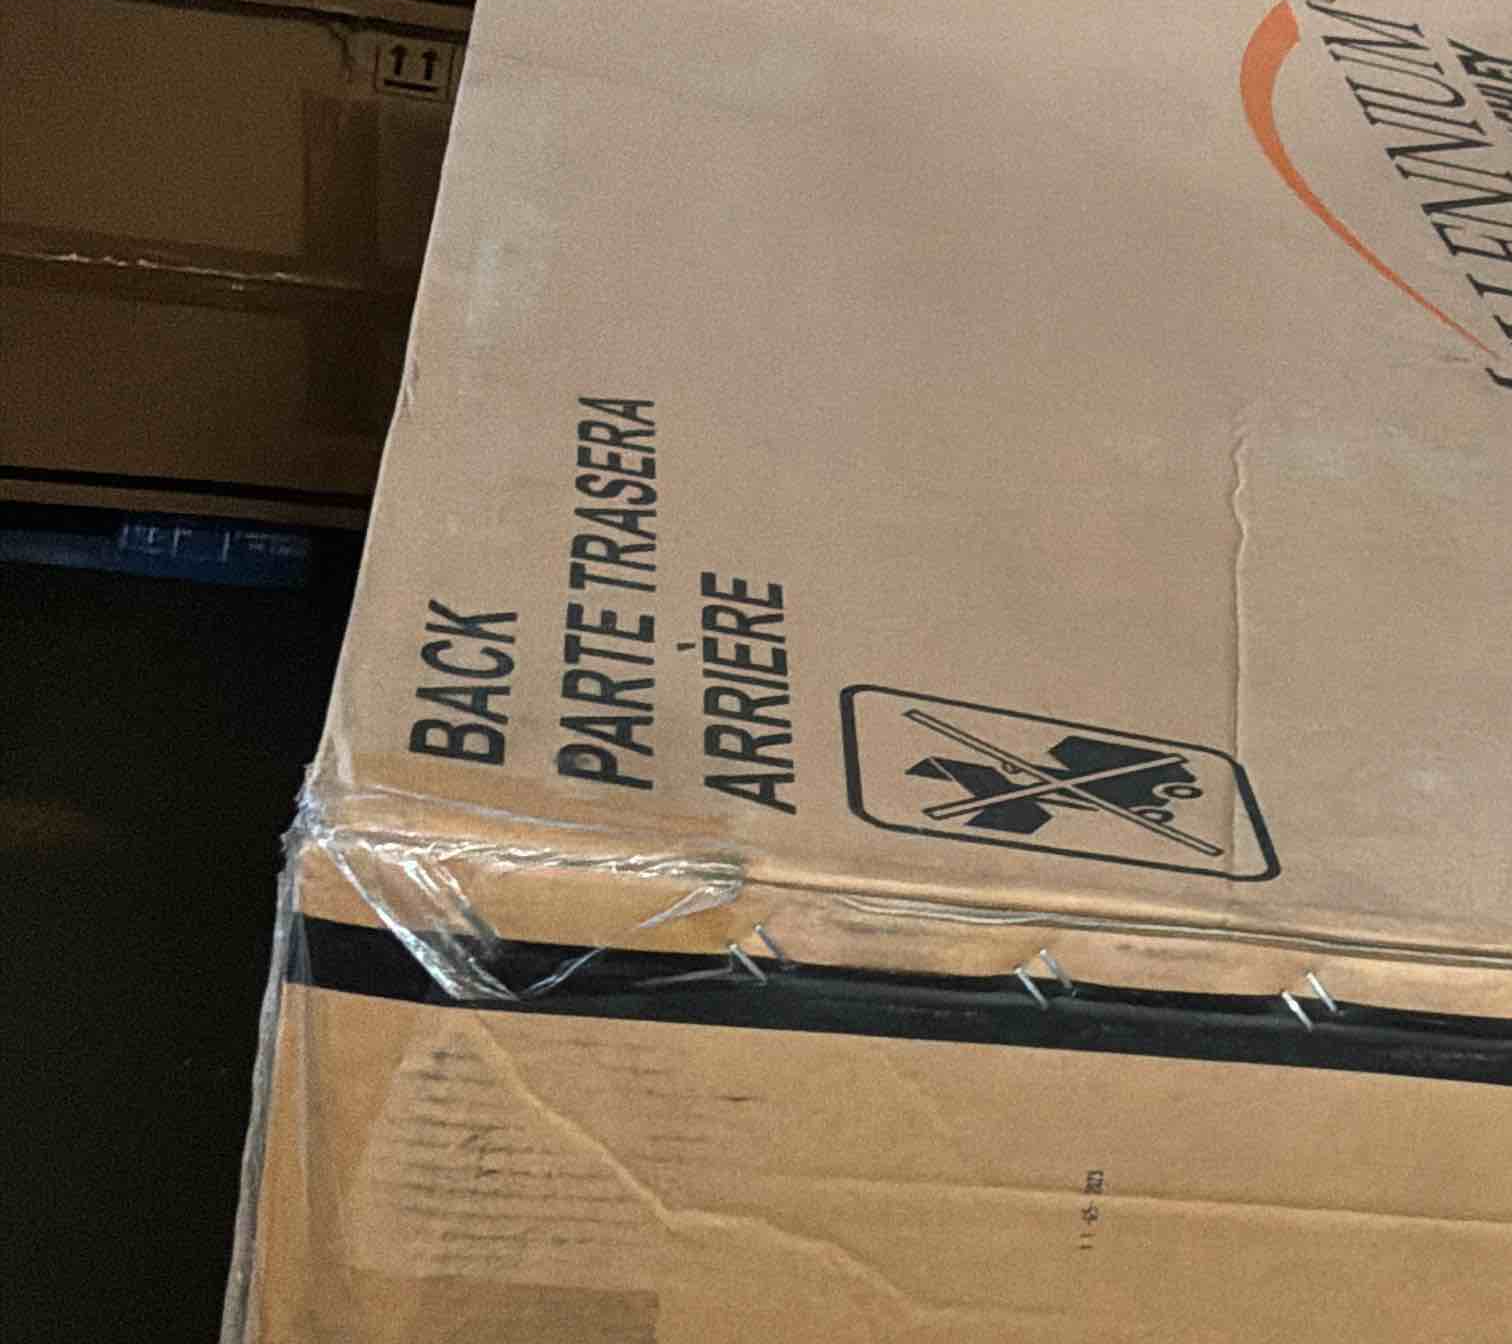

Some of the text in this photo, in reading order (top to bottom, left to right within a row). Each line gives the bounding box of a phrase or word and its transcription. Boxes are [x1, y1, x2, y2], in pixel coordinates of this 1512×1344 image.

[409, 597, 519, 767] BACK
[557, 394, 657, 791] PARTE TRASERA
[677, 571, 797, 816] ARRIÈRE
